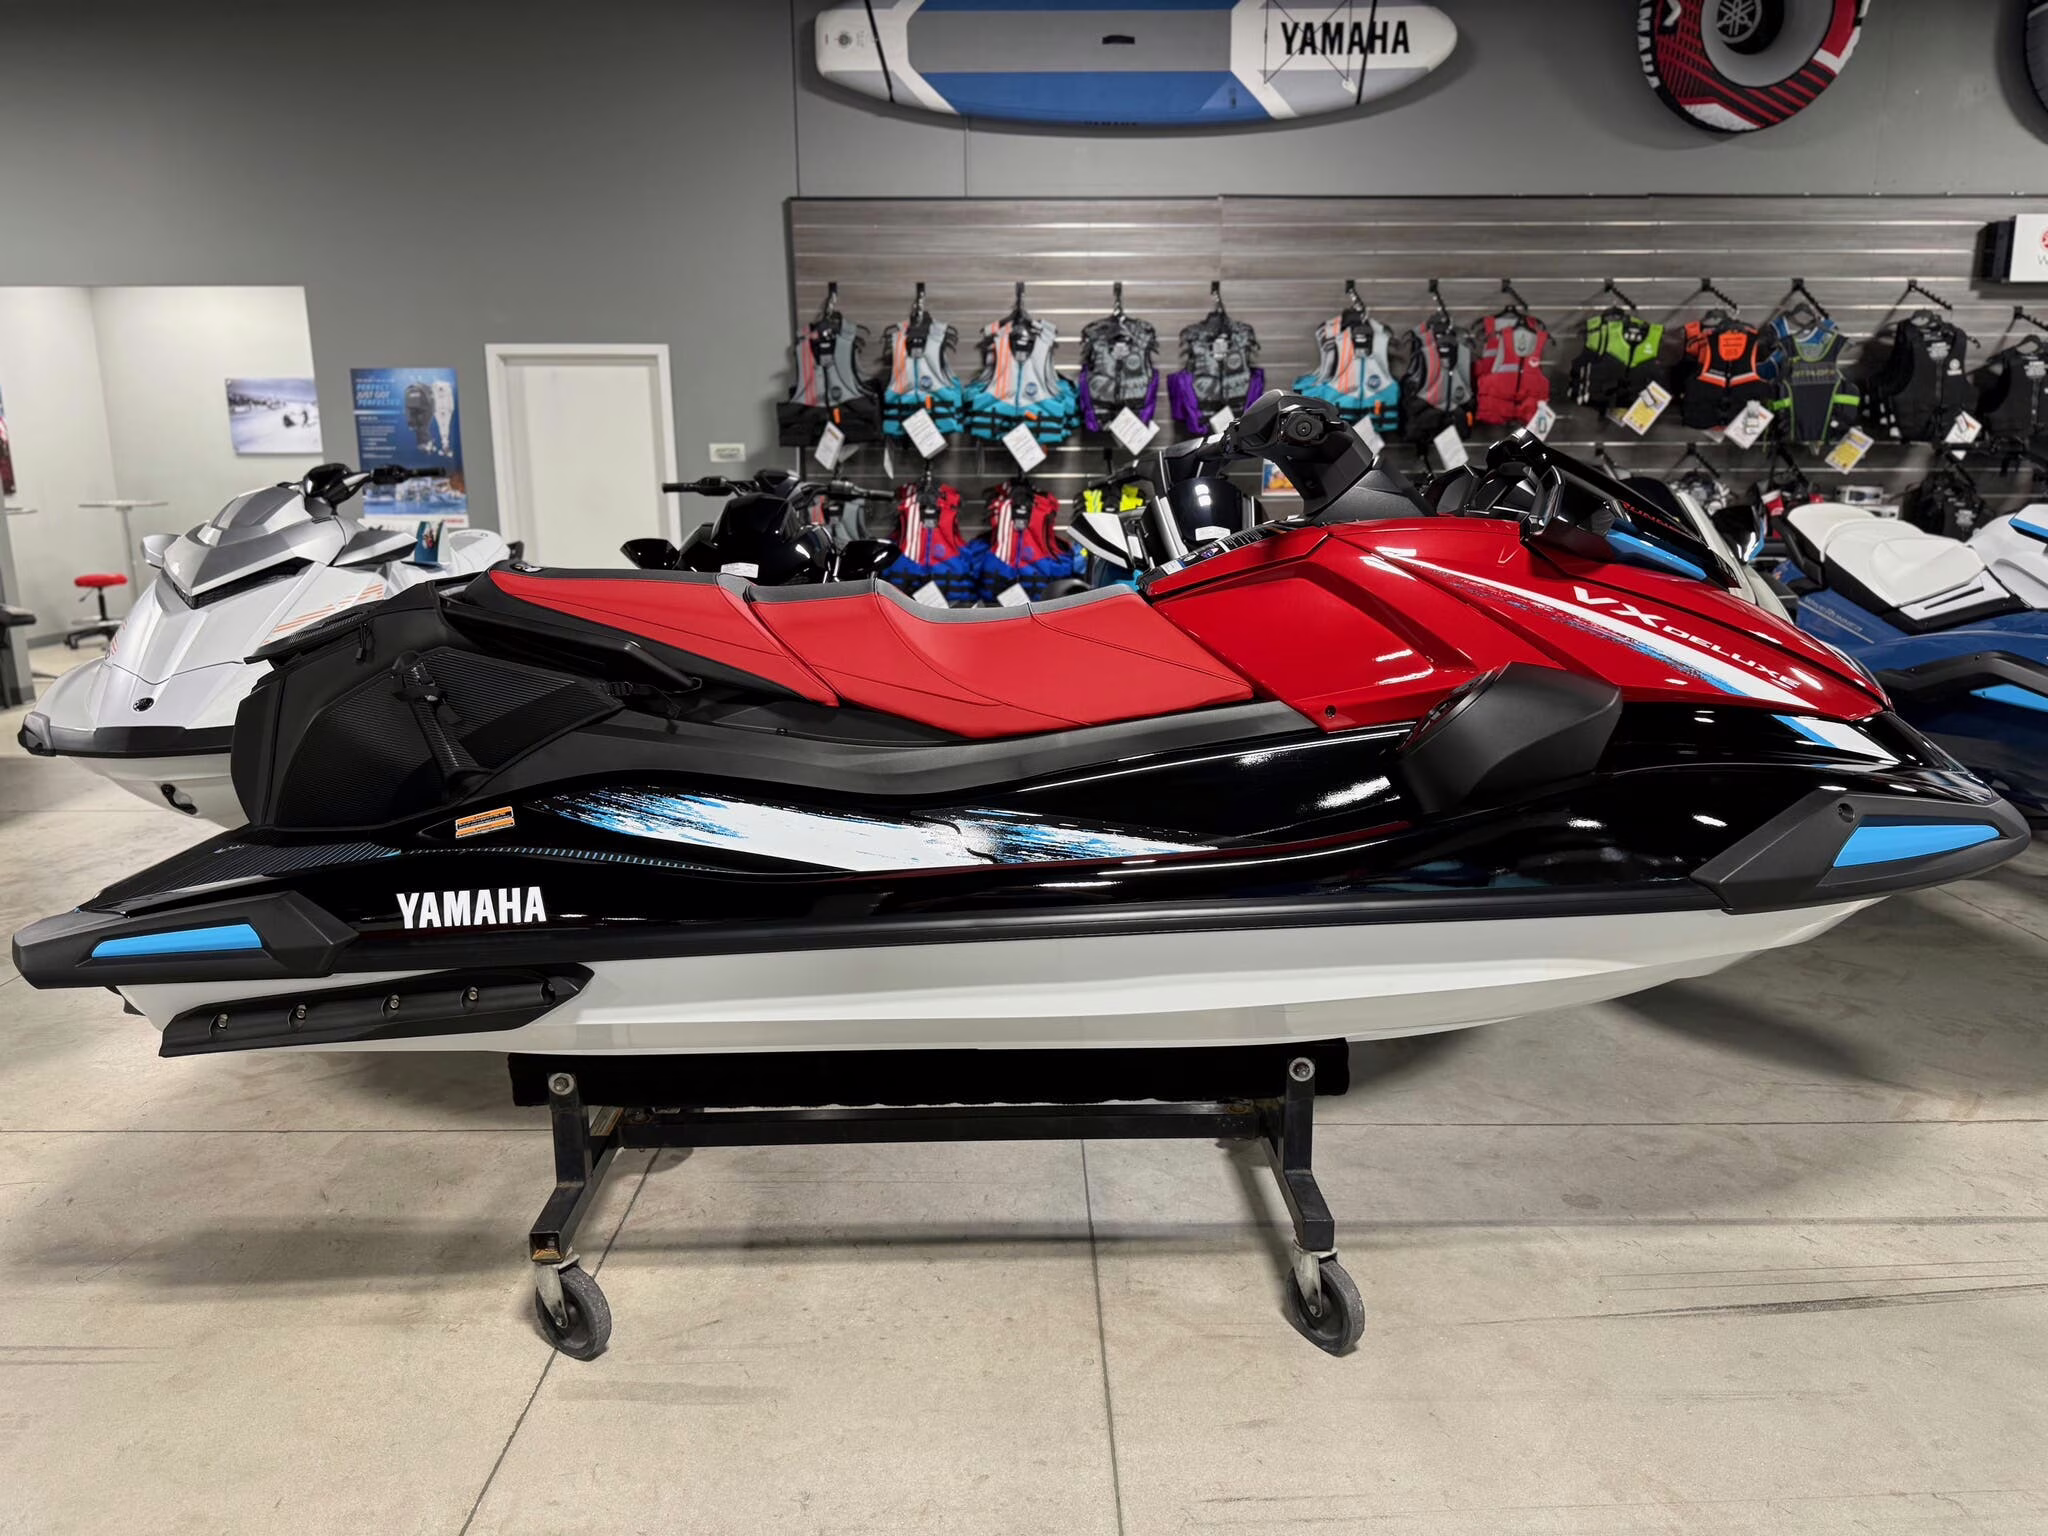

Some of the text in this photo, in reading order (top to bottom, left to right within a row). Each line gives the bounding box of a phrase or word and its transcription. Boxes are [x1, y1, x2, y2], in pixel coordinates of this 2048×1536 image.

[1281, 20, 1410, 55] YAMAHA
[1573, 586, 1802, 690] VX DELUXE
[396, 886, 547, 930] YAMAHA
